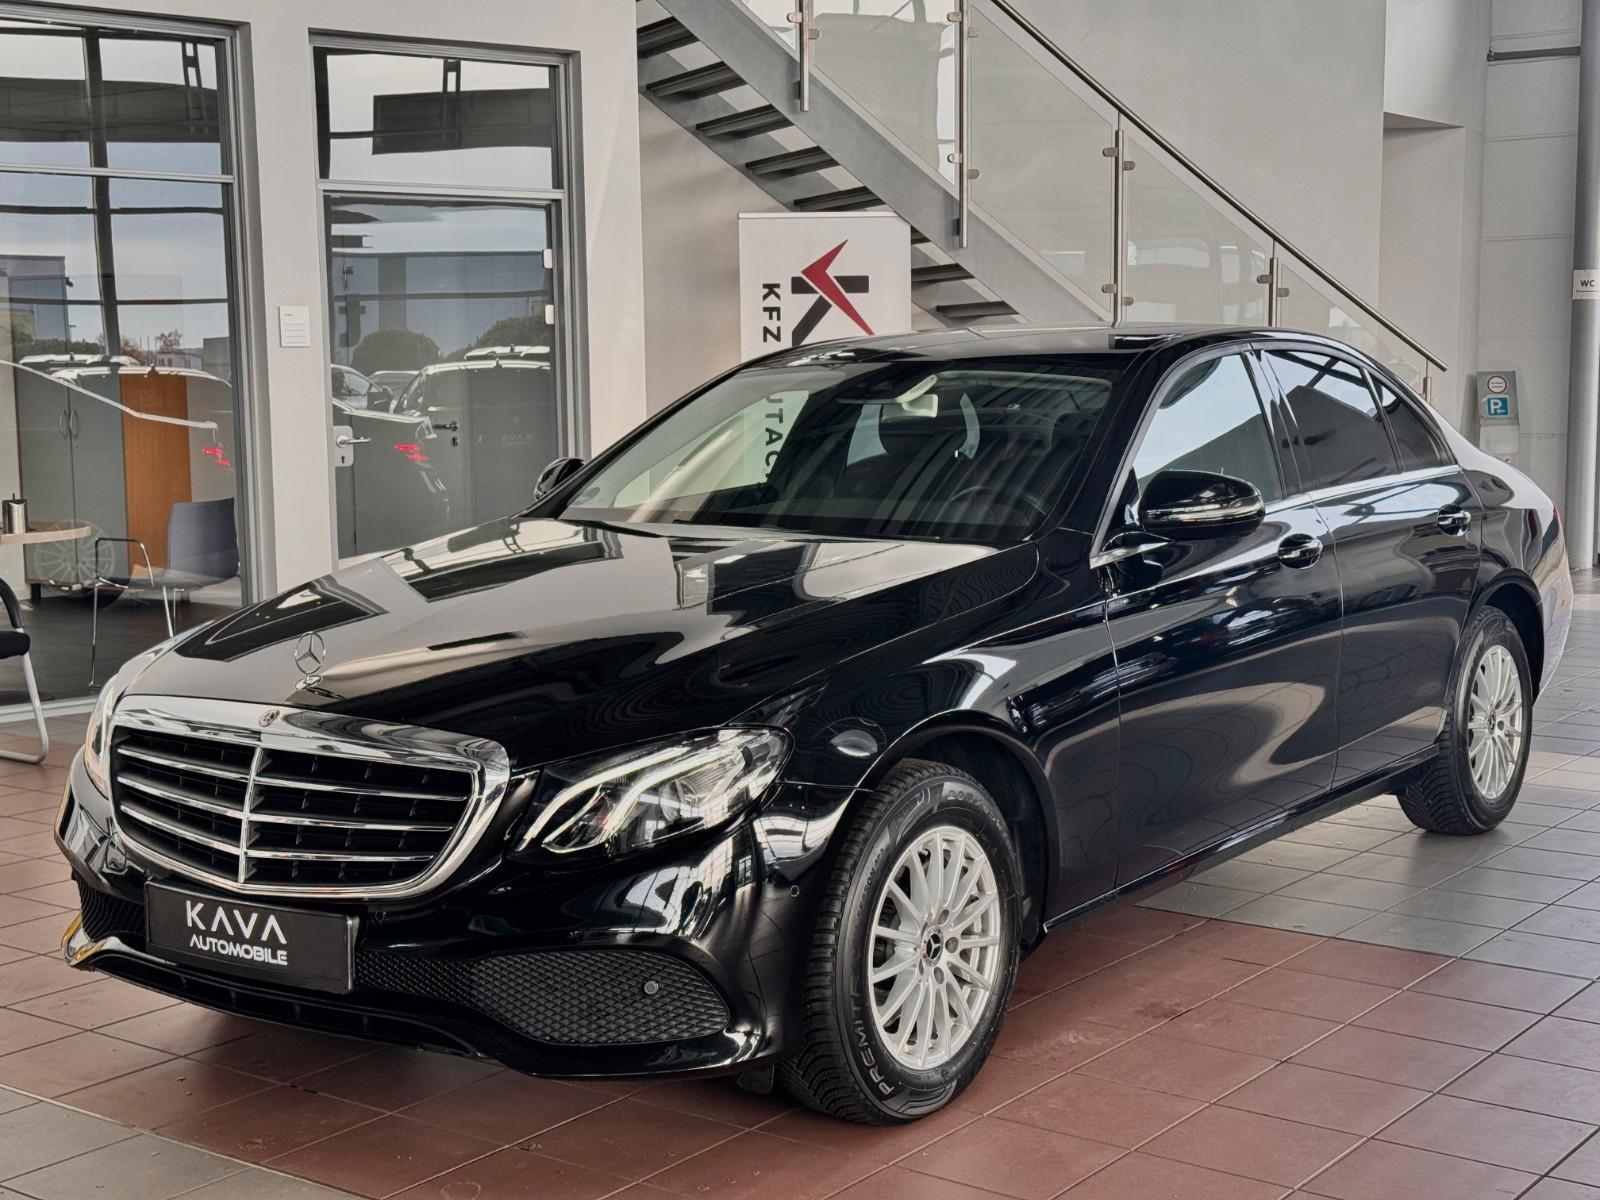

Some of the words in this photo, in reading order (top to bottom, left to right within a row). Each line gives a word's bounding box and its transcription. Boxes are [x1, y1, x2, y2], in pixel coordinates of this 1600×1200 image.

[1580, 279, 1596, 288] WC
[762, 283, 781, 343] KFZ
[765, 396, 784, 478] UTAC
[185, 900, 288, 945] KAVA
[189, 933, 288, 966] AUTOMOBILE
